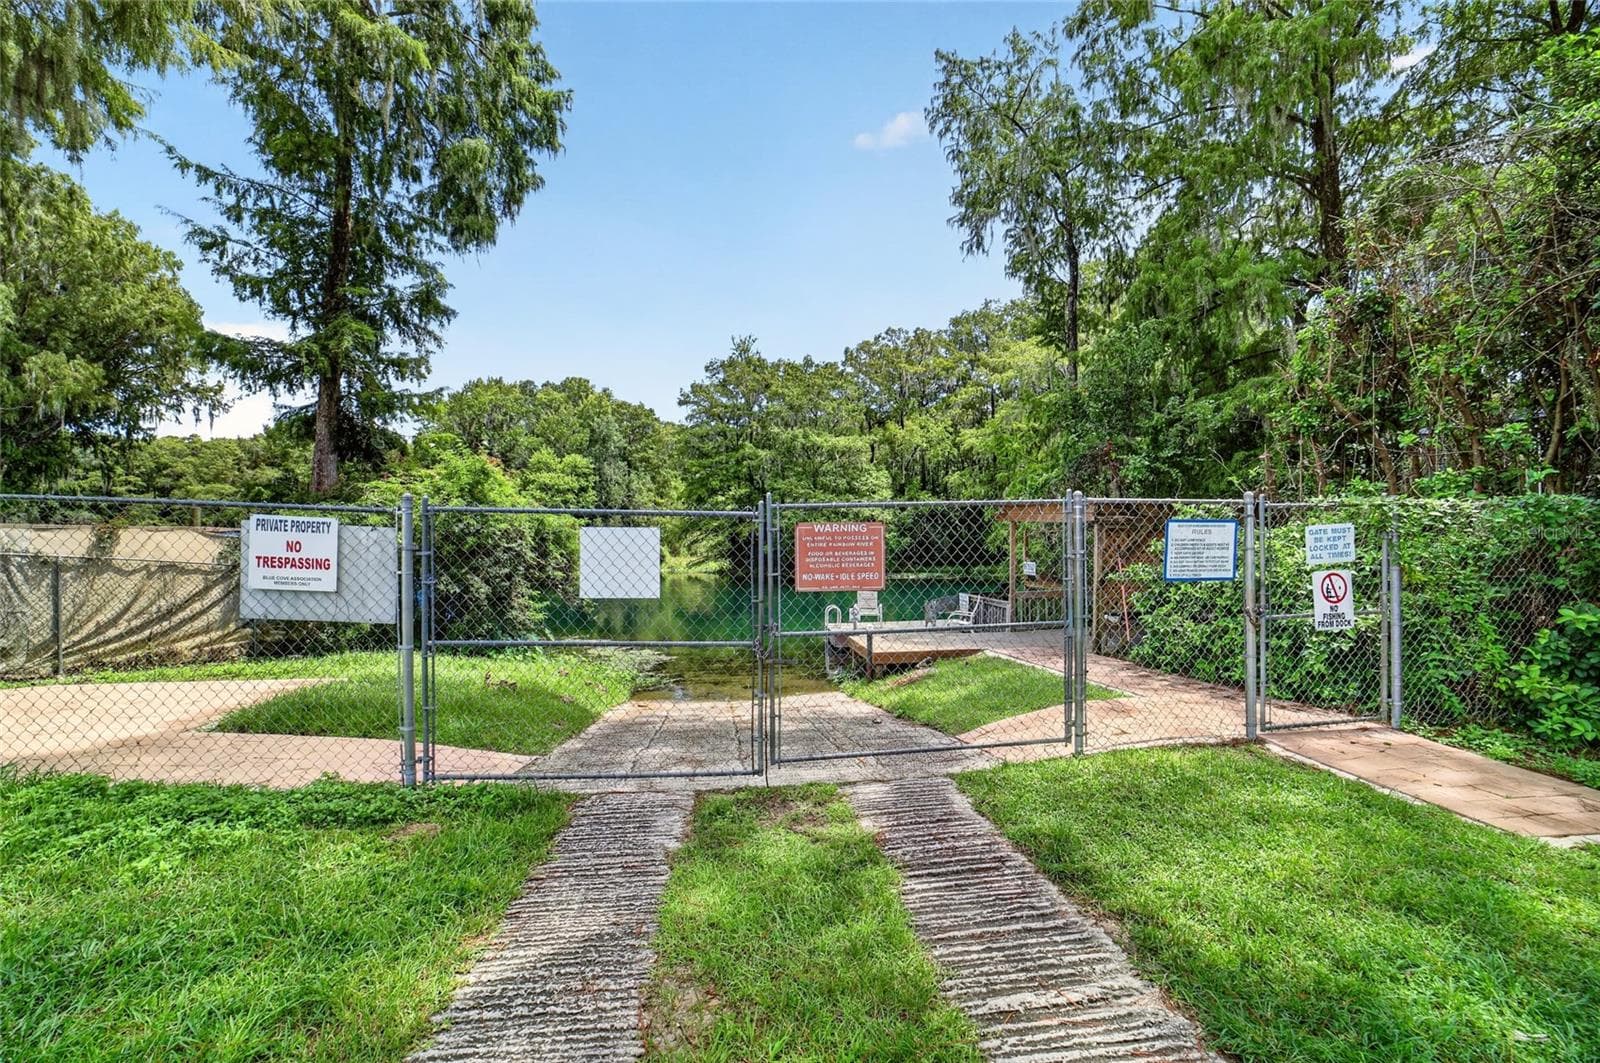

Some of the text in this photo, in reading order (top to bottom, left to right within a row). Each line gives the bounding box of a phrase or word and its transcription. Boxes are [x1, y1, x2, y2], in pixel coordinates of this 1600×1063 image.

[255, 518, 331, 534] PRIVATE PROPERTY
[814, 524, 867, 532] WARNING
[1308, 528, 1328, 536] GATE
[286, 540, 302, 553] NO
[1309, 544, 1338, 552] LOCKED
[255, 556, 331, 570] TRESPASSING
[857, 572, 879, 580] SPEED
[1322, 612, 1345, 620] FISHING
[1317, 619, 1352, 628] FROM DOCK
